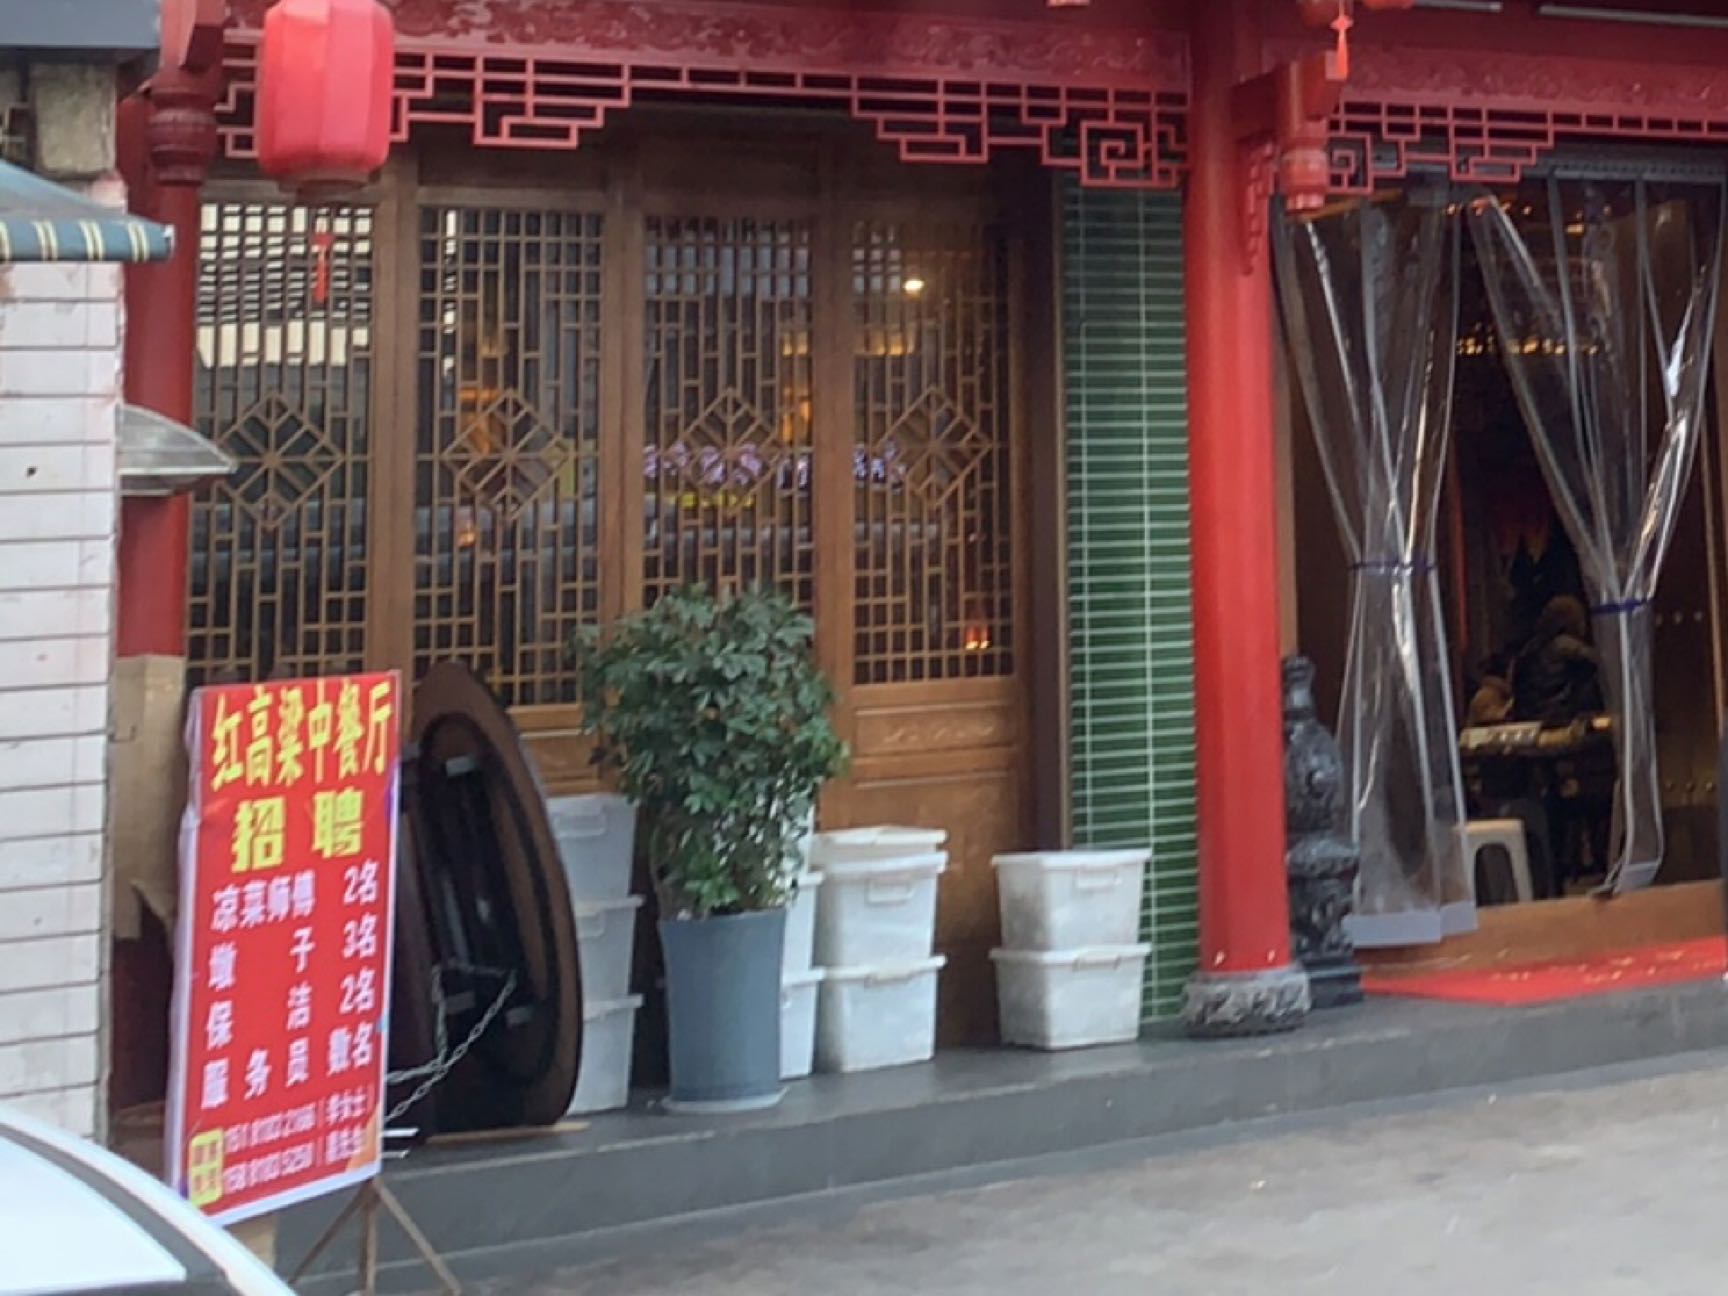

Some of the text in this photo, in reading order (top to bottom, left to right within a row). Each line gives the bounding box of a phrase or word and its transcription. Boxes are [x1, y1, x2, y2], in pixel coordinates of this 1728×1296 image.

[231, 786, 364, 874] 招聘
[342, 858, 380, 906] 2名
[342, 911, 378, 959] 3名
[339, 965, 376, 1015] 2名
